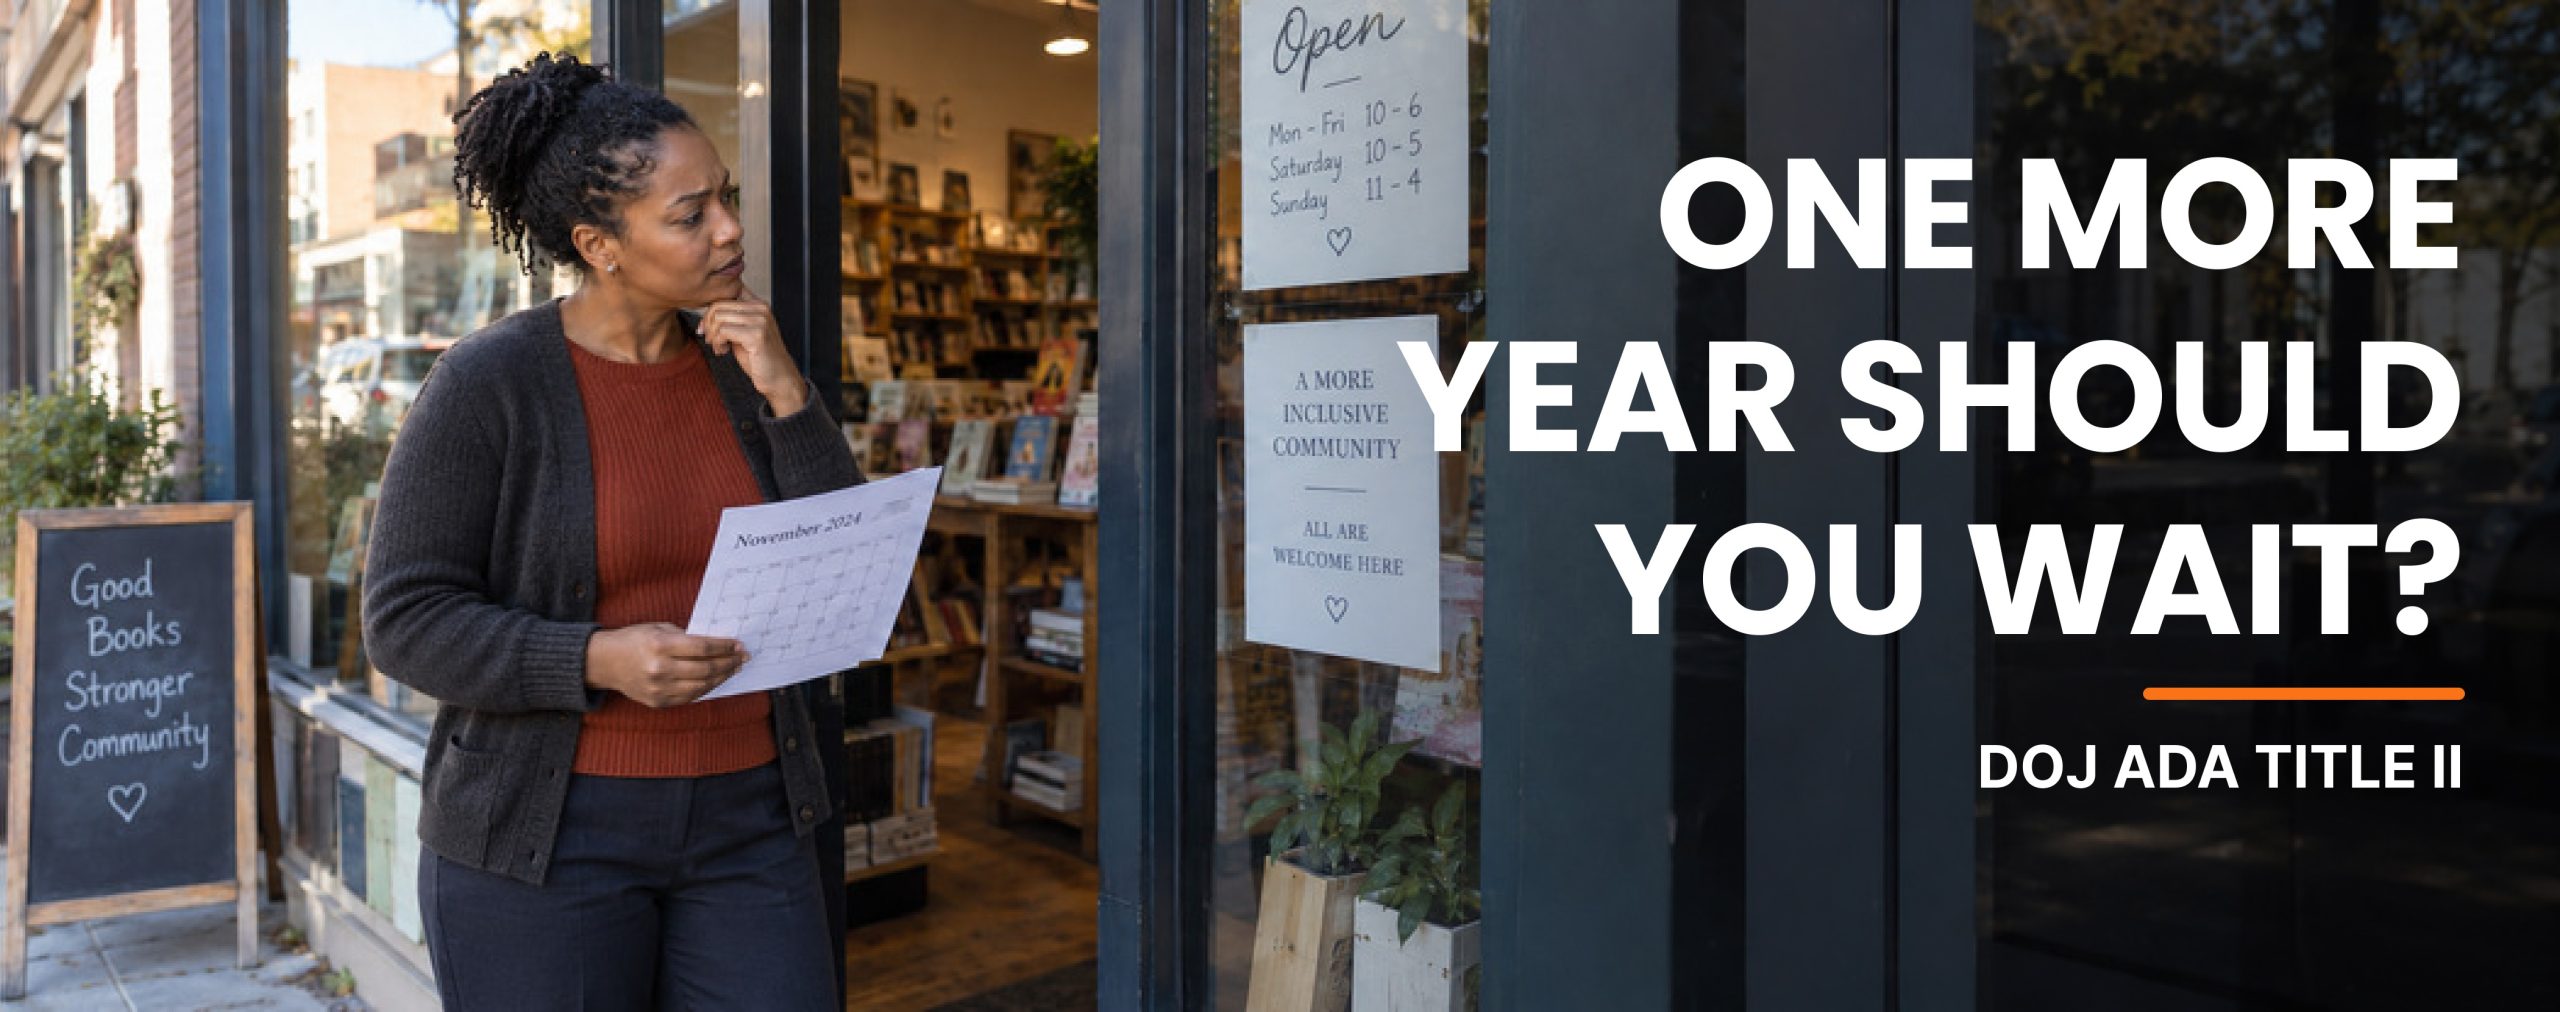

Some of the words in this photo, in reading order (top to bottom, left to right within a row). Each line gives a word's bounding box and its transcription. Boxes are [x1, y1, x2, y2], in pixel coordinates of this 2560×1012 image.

[1273, 7, 1405, 93] Open
[1269, 123, 1301, 146] Mon
[1322, 110, 1344, 135] Fri
[1366, 100, 1385, 127] 10
[1409, 93, 1422, 117] 6
[1270, 151, 1342, 183] Saturday
[1366, 139, 1385, 164] 10
[1409, 130, 1422, 156] 5
[1270, 190, 1328, 220] Sunday
[1366, 176, 1383, 201] 11
[1408, 168, 1421, 194] 4
[1295, 371, 1309, 390] A
[1314, 370, 1374, 390] MORE
[1283, 404, 1389, 424] INCLUSIVE
[1273, 437, 1401, 460] COMMUNITY
[734, 522, 822, 549] November
[824, 512, 862, 532] 2024
[1303, 522, 1332, 539] ALL
[1336, 523, 1368, 541] ARE
[71, 558, 154, 610] Good
[1273, 546, 1352, 571] WELCOME
[1358, 556, 1403, 576] HERE
[86, 611, 182, 657] Books
[65, 670, 195, 719] Stronger
[58, 712, 209, 769] Community
